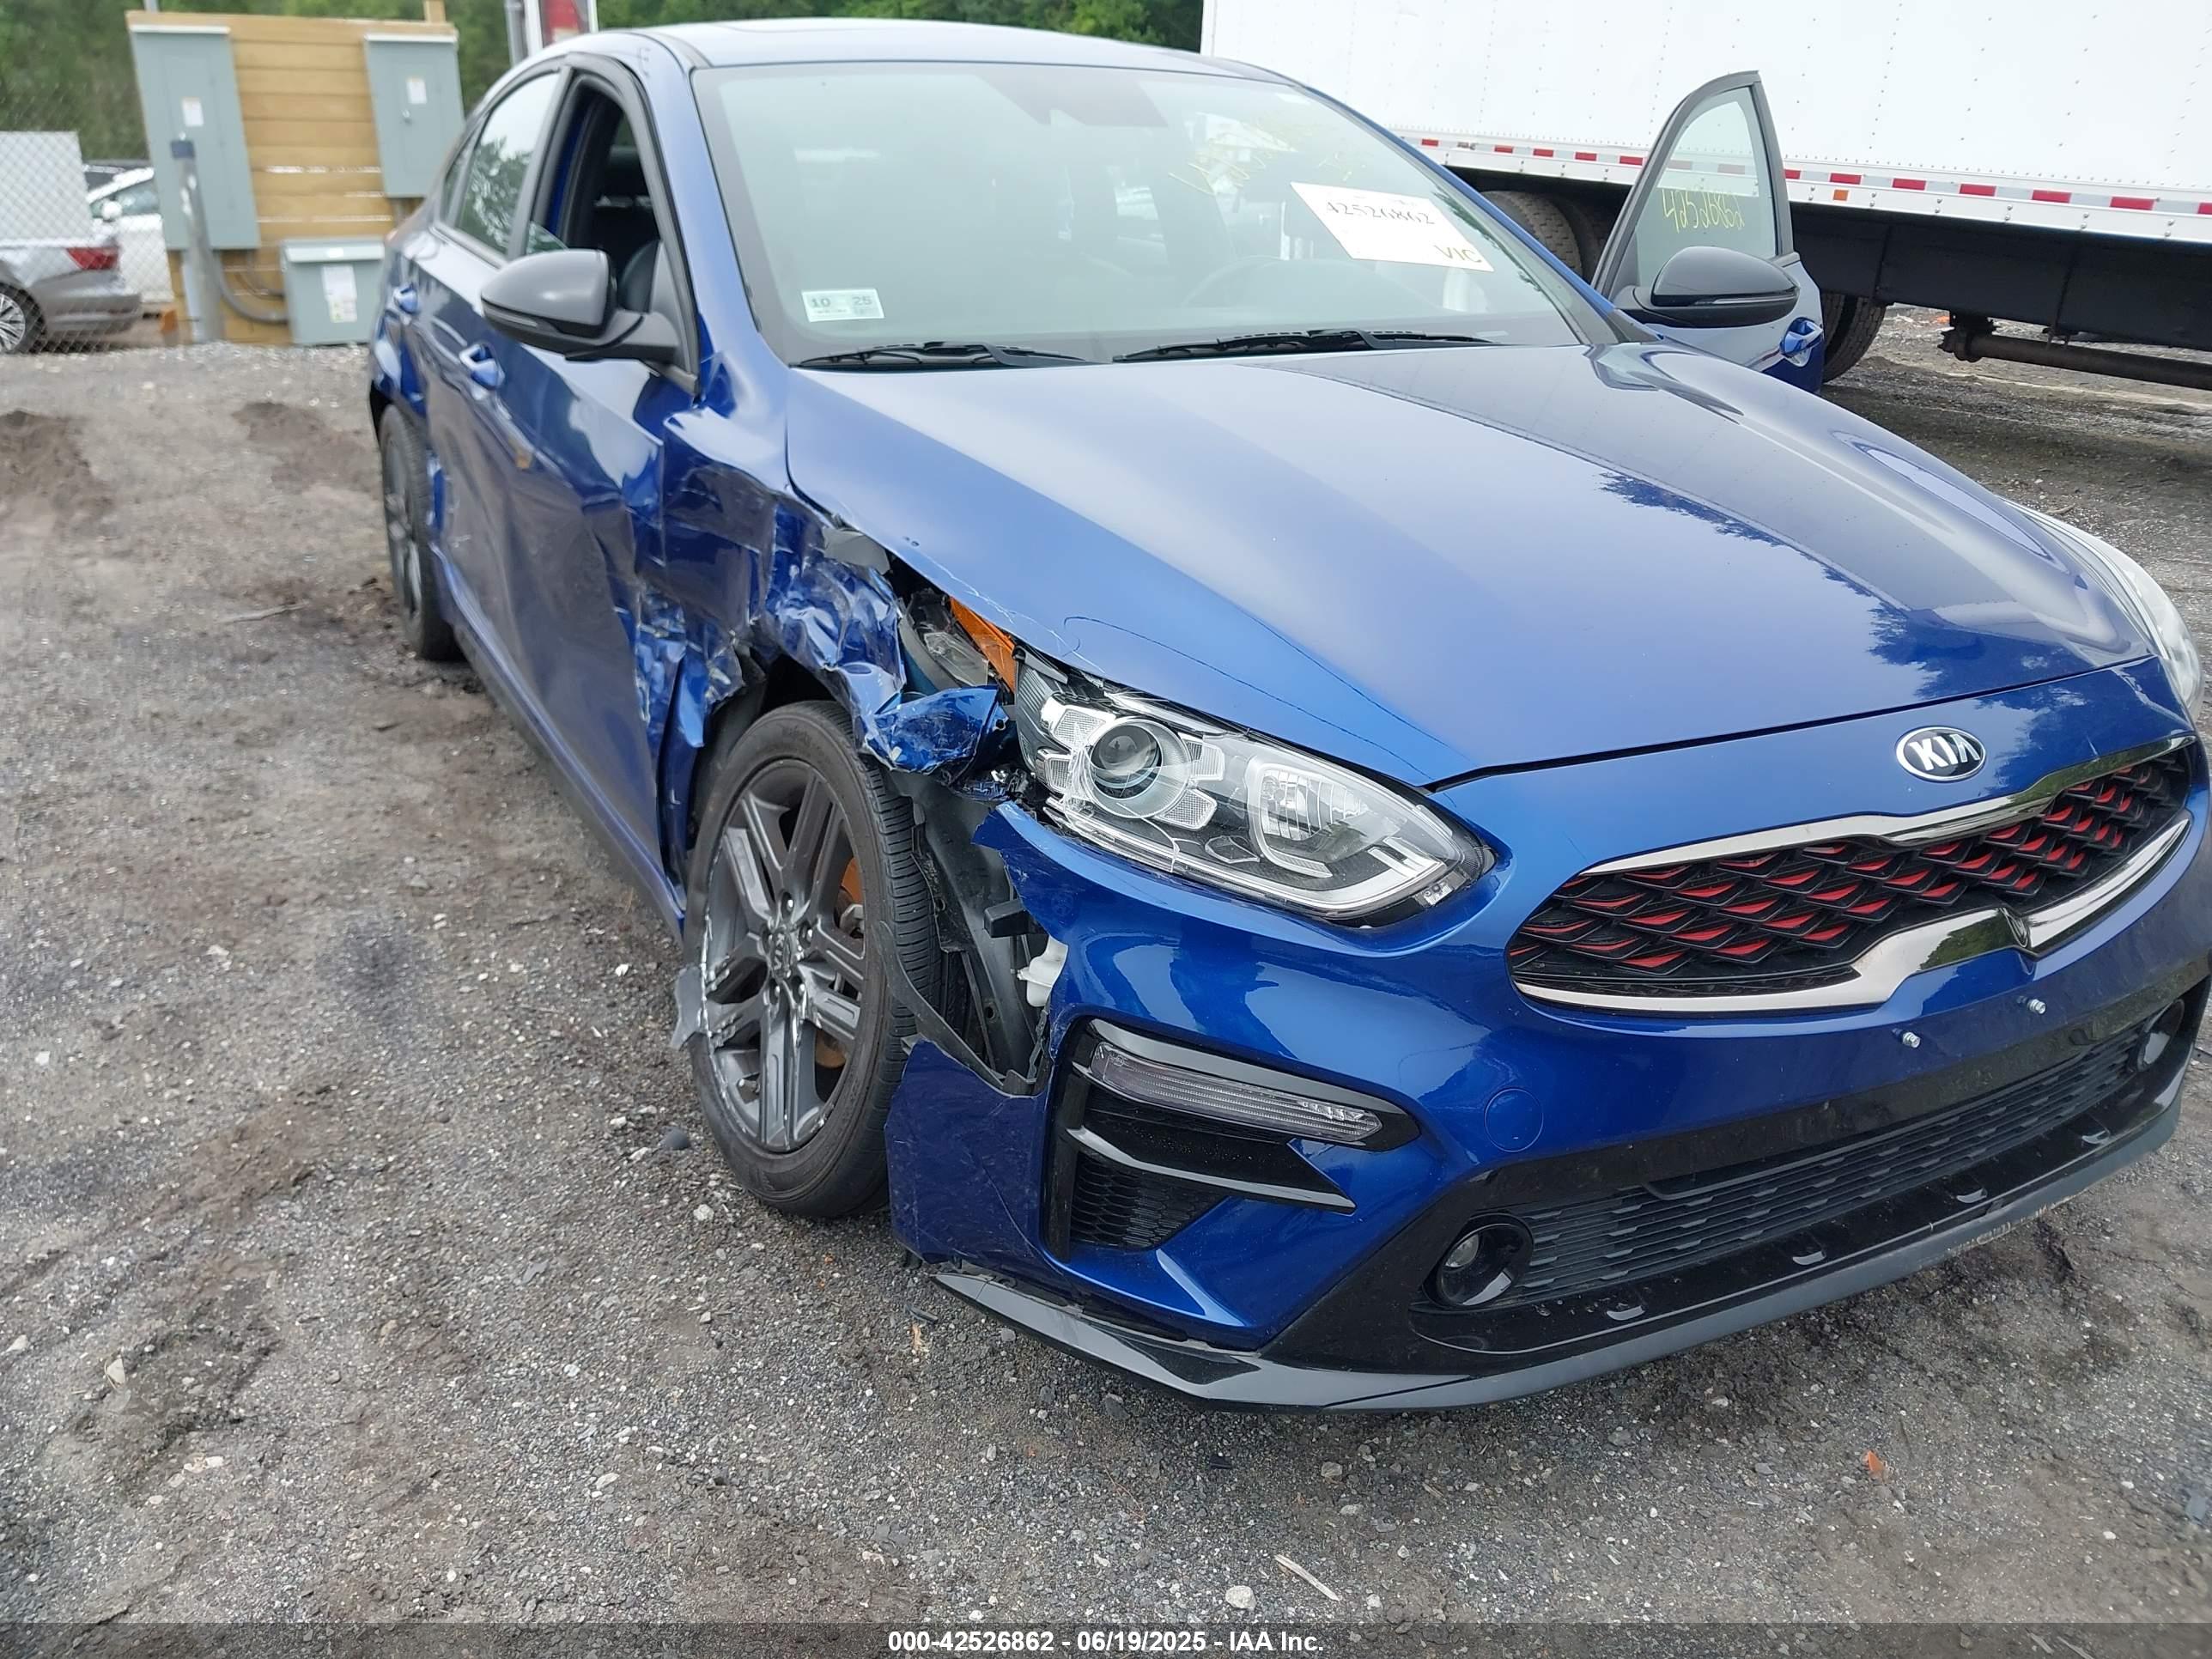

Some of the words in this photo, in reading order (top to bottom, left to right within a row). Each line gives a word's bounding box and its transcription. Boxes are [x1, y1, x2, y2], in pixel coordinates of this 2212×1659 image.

[1434, 245, 1483, 264] VIC
[811, 297, 831, 308] 10
[852, 295, 873, 306] 25
[1907, 733, 1981, 771] KIA
